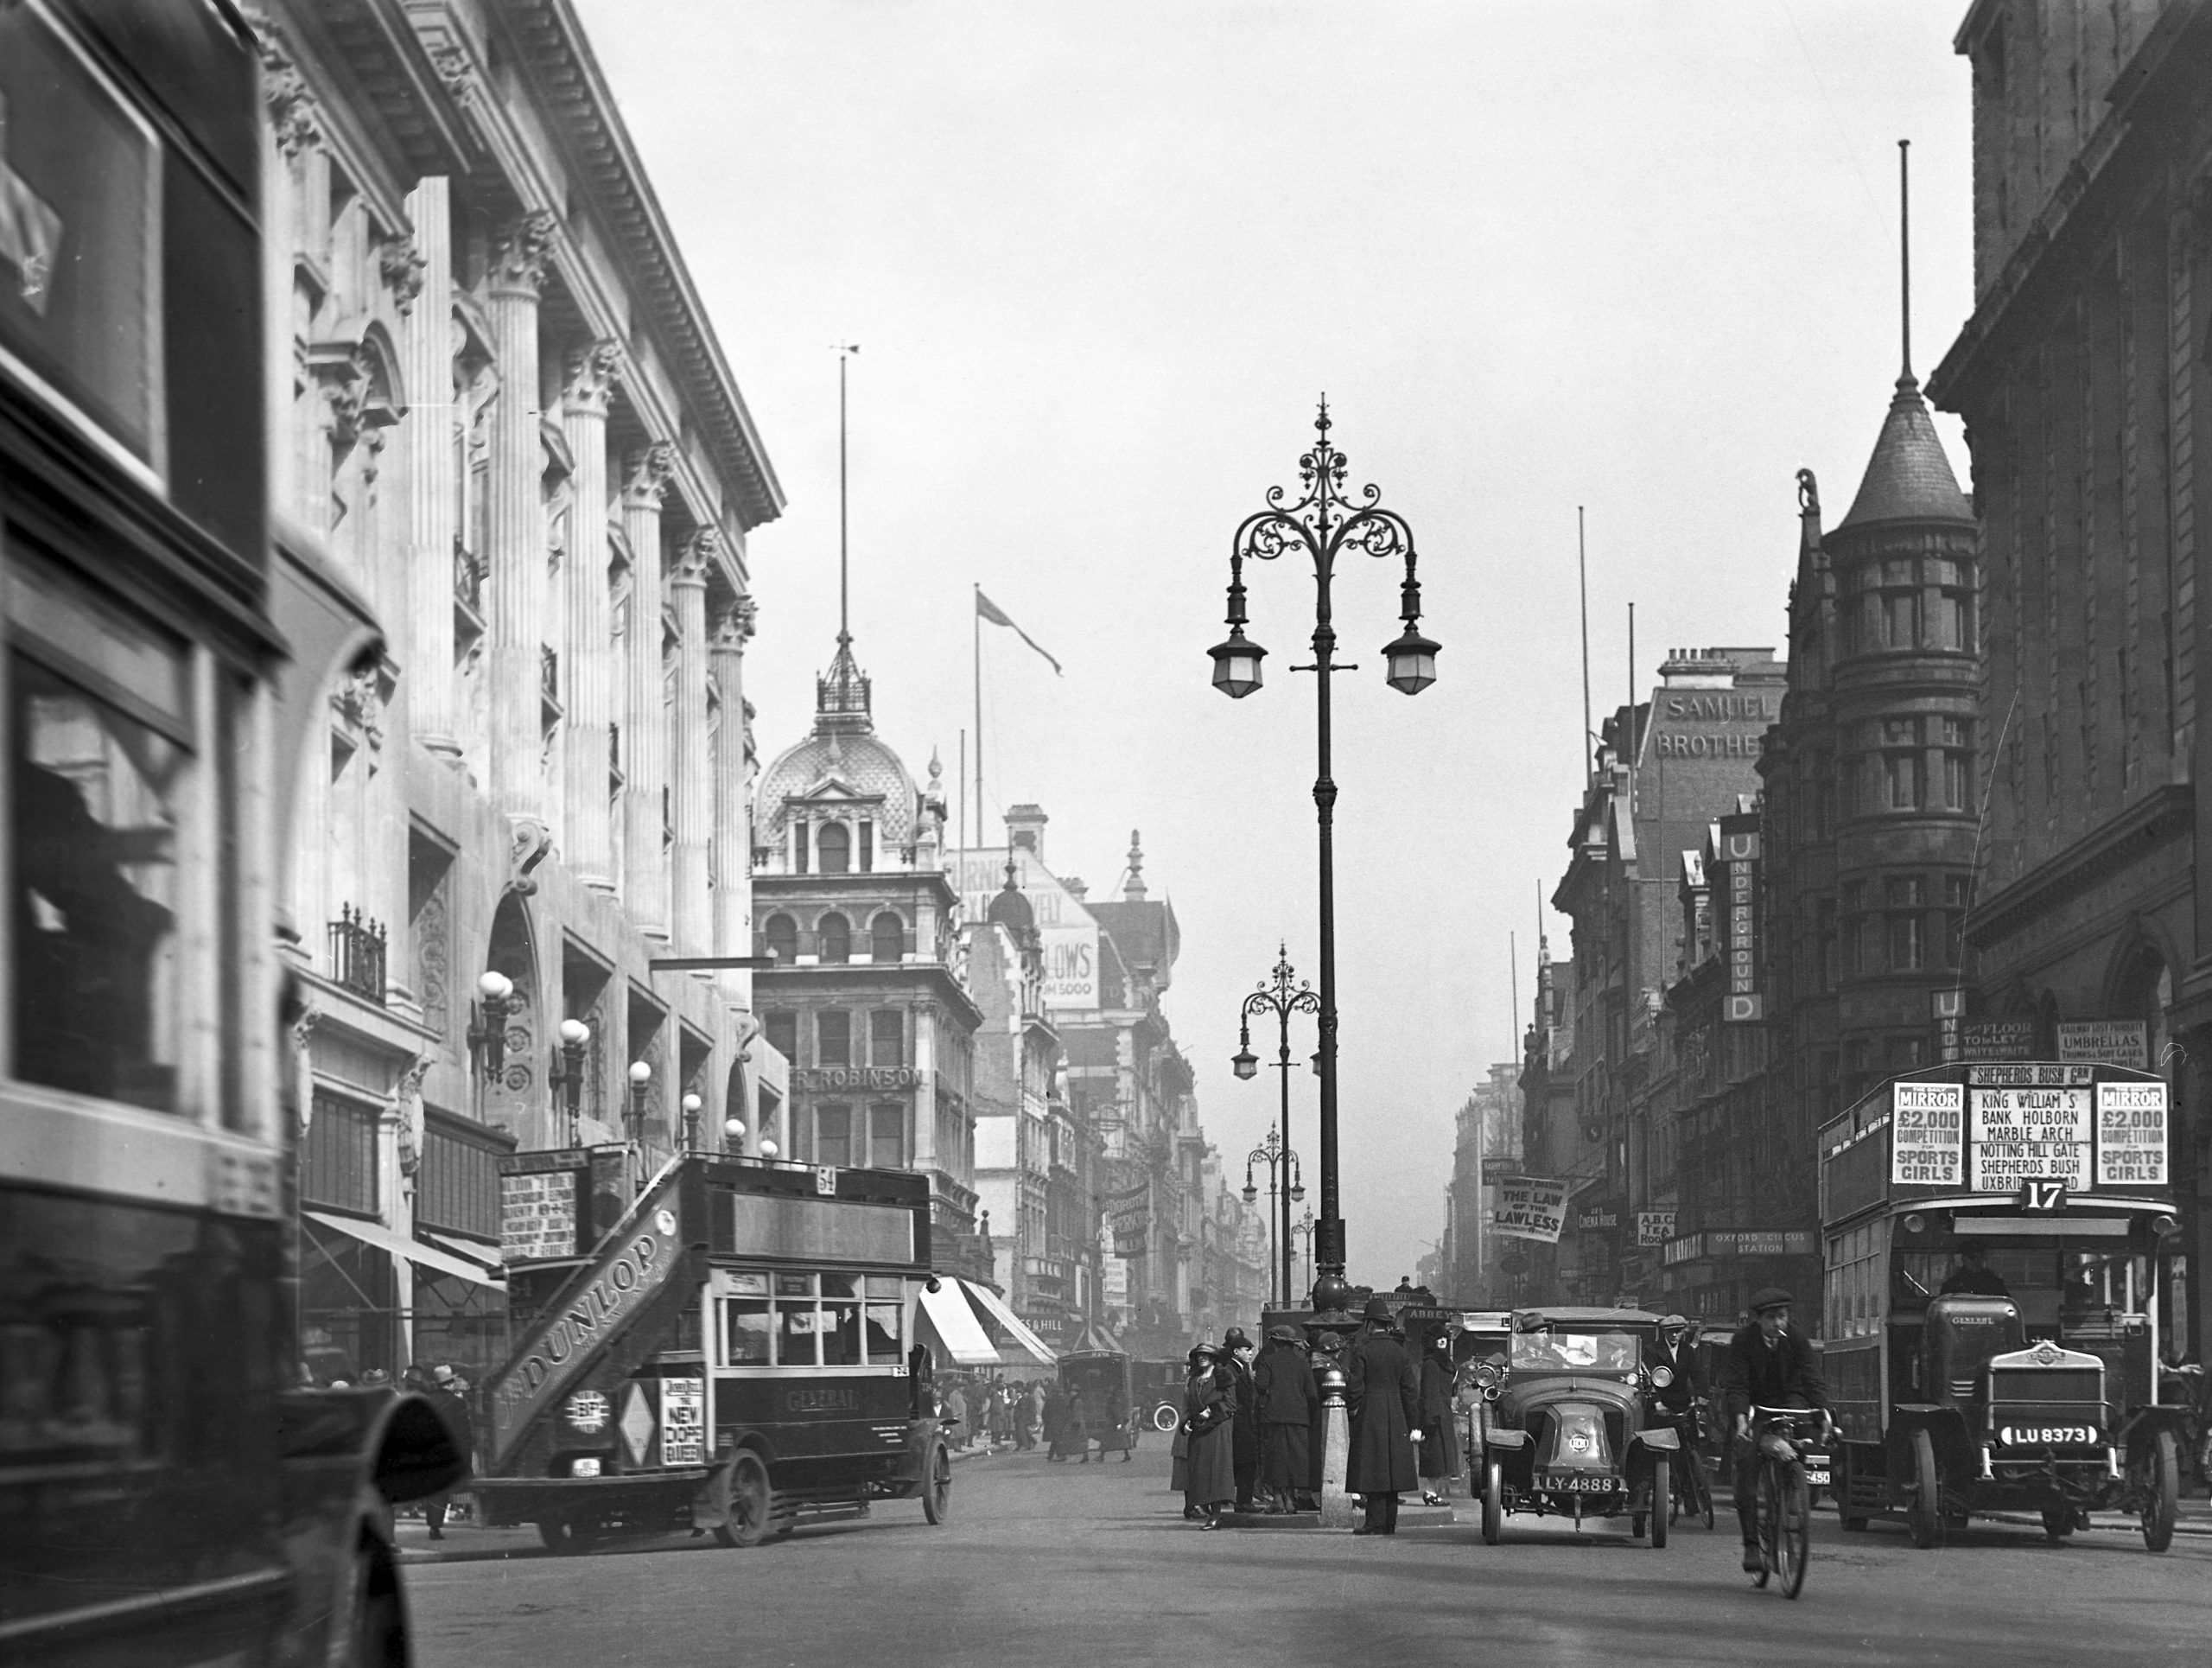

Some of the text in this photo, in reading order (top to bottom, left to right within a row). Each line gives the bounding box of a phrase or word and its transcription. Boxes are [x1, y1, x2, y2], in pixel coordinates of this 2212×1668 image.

[1669, 697, 1774, 717] SAMUEL
[1656, 734, 1760, 755] BROTHE
[1729, 835, 1754, 1020] UNDERGROUND
[1044, 943, 1092, 979] LOWS
[1058, 983, 1093, 995] 5000
[1982, 1023, 2031, 1035] FLOOR
[1963, 1035, 2017, 1045] TO LET
[2063, 1035, 2139, 1048] UMBRELLAS
[820, 1069, 923, 1086] ROBINSON
[1977, 1066, 2032, 1084] SHEPHERDS
[2039, 1066, 2064, 1084] BUSH
[1900, 1092, 1957, 1106] MIRROR
[1982, 1093, 2009, 1108] KING
[2018, 1092, 2061, 1108] WILLIAM
[2103, 1092, 2160, 1106] MIRROR
[1897, 1111, 1960, 1129] £2,000
[1982, 1111, 2078, 1124] BANK HOLBORN
[2101, 1111, 2164, 1130] £2,000
[1897, 1130, 1960, 1144] COMPETITION
[1987, 1127, 2073, 1141] MARBLE ARCH
[2101, 1130, 2164, 1143] COMPETITION
[1980, 1143, 2079, 1157] NOTTING HILL GATE
[2101, 1150, 2164, 1164] SPORTS
[1897, 1150, 1959, 1165] SPORTS
[1901, 1166, 1953, 1180] GIRLS
[1981, 1160, 2079, 1174] SHEPHERDS BUSH
[2107, 1166, 2158, 1180] GIRLS
[1982, 1176, 2022, 1189] UXBRID
[1503, 1190, 1563, 1206] THE LAW
[2028, 1182, 2063, 1208] 17
[1529, 1204, 1548, 1213] THE
[1496, 1211, 1560, 1232] LAWLESS
[1579, 1213, 1617, 1228] CINEMA HOUSE
[1643, 1225, 1670, 1235] TEA
[1641, 1234, 1665, 1244] ROO
[1715, 1232, 1805, 1243] OXFORD CIRCUS
[1738, 1245, 1783, 1253] STATION
[518, 1234, 658, 1398] DUNLOP
[1409, 1310, 1451, 1319] ABBEY
[1952, 1316, 1994, 1325] GENERAL
[1040, 1319, 1063, 1331] HILL
[786, 1389, 859, 1411] GENERAL
[668, 1406, 698, 1424] NEW
[2016, 1428, 2086, 1443] LU 8373
[1546, 1477, 1612, 1492] LY-4888
